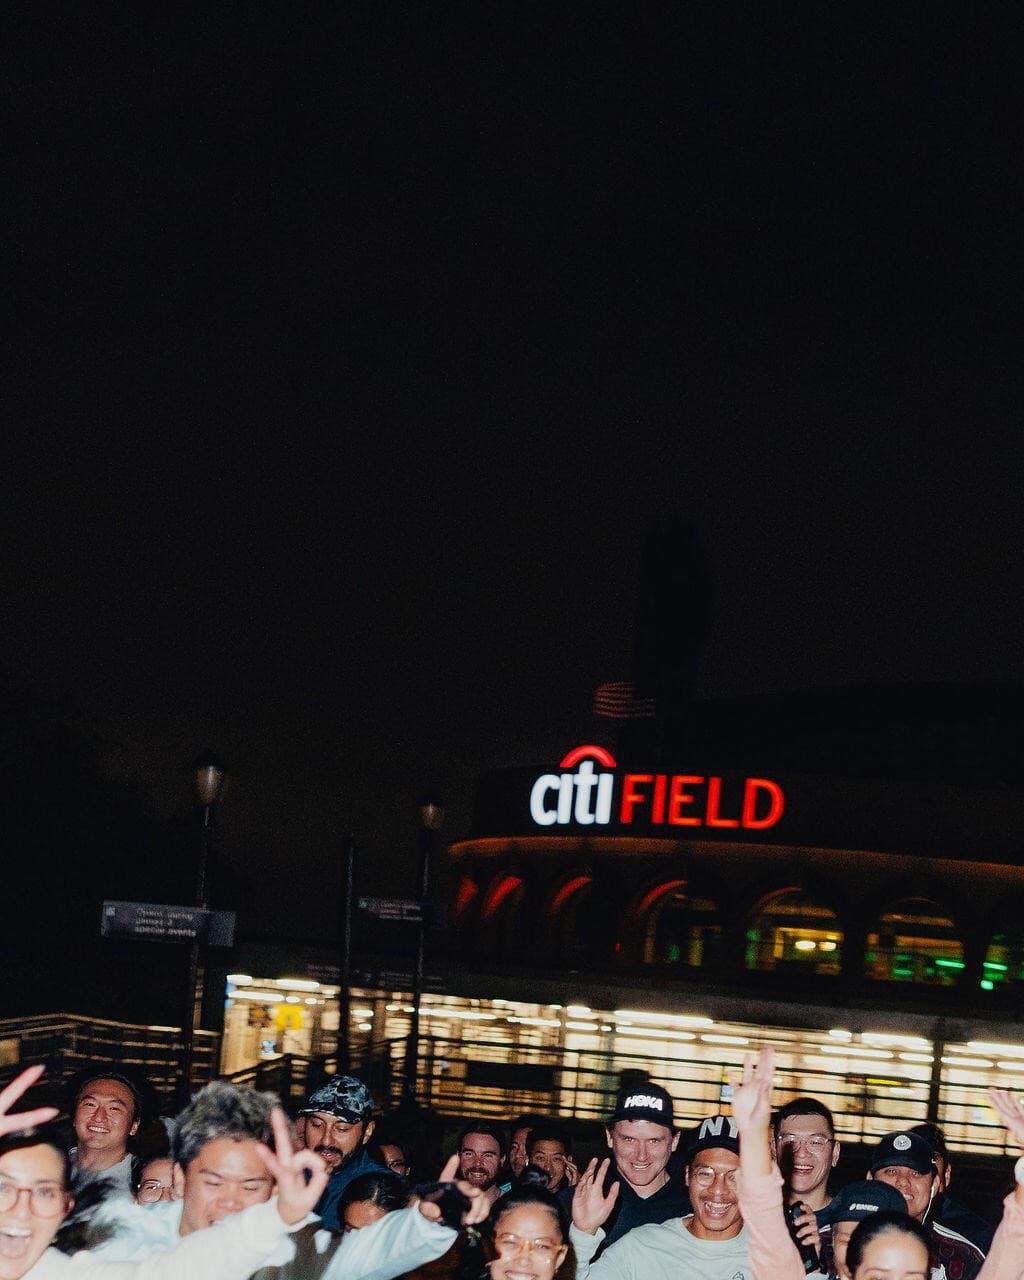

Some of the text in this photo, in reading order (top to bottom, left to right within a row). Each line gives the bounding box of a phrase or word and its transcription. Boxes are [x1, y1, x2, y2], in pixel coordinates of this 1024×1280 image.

[529, 757, 786, 830] citi FIELD
[624, 1094, 663, 1111] HOKA
